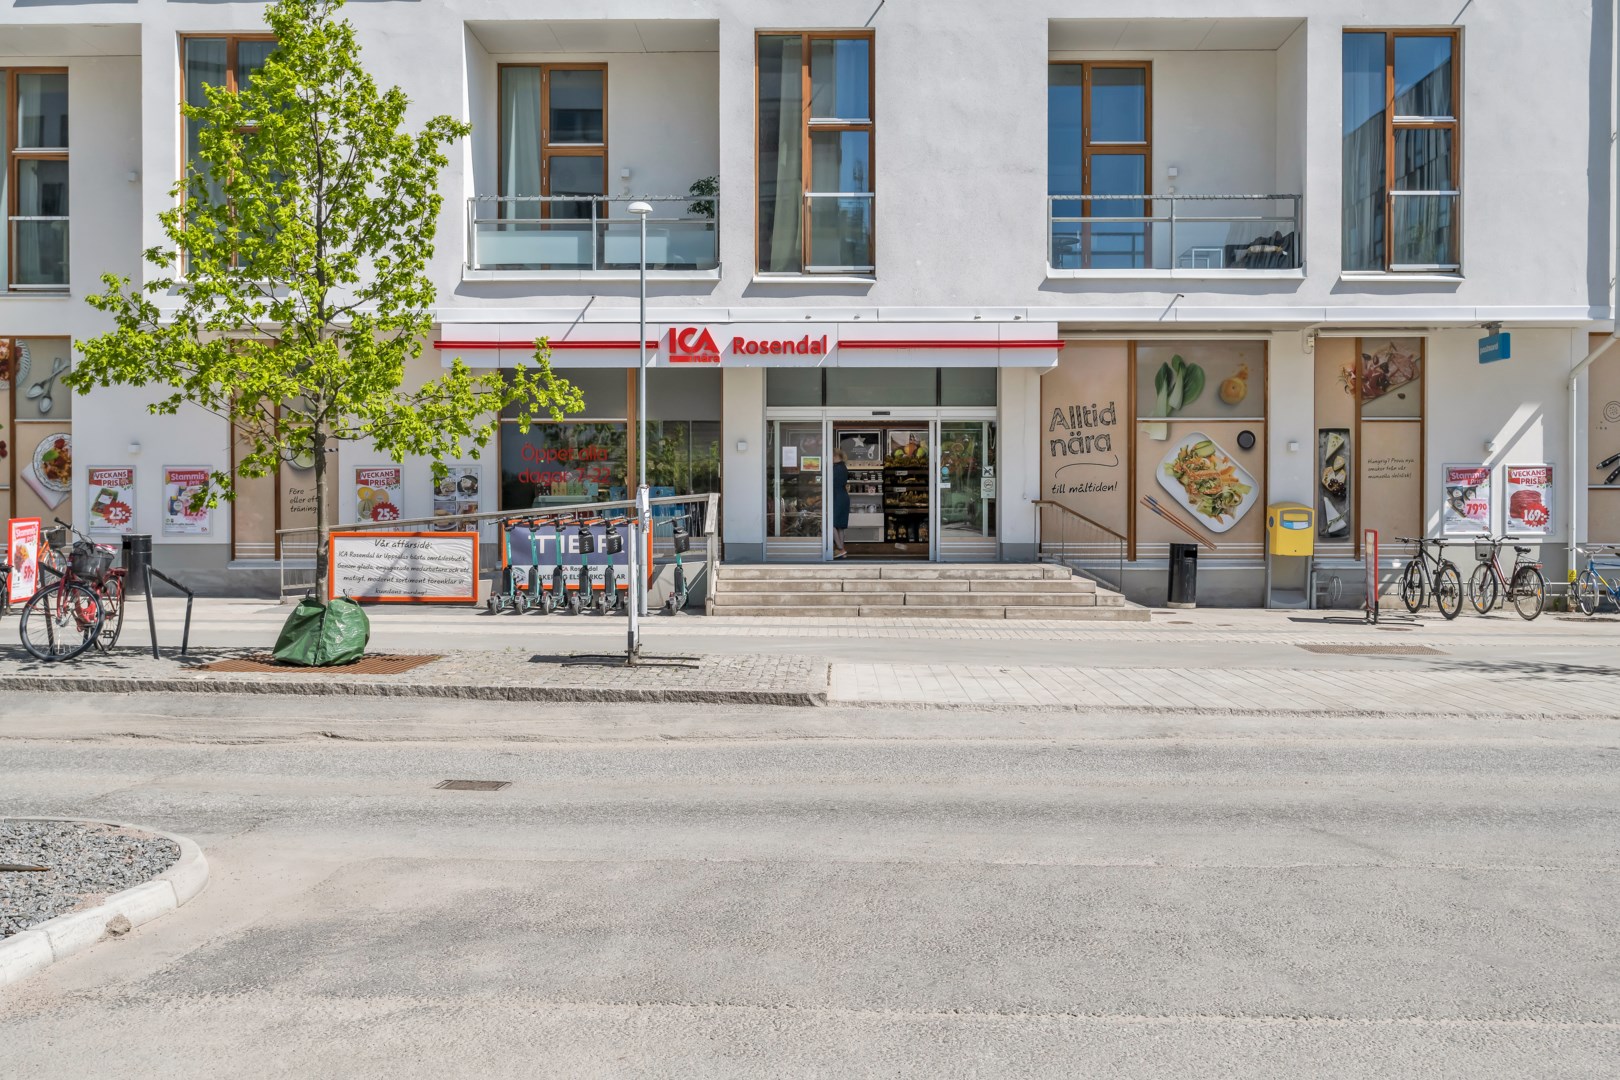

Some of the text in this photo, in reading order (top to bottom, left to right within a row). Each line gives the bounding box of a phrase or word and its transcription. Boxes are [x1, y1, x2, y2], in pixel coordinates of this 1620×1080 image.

[669, 327, 827, 354] ICA Rosendal
[1049, 401, 1117, 432] Alltid
[1050, 431, 1112, 457] nära
[521, 442, 608, 464] Öppet alla
[94, 470, 127, 479] VECKANS
[170, 472, 205, 481] Stammis
[363, 470, 394, 479] VECKANS
[518, 467, 567, 486] dagar
[1451, 470, 1486, 480] Stammis
[1513, 469, 1546, 477] VECKANS
[289, 487, 305, 495] Före
[1051, 481, 1118, 494] till måltiden!
[290, 496, 306, 504] eller
[109, 507, 130, 518] 25:-
[290, 505, 317, 514] träning
[377, 508, 397, 520] 25:-
[1523, 509, 1547, 521] 169:-
[374, 539, 433, 549] Vår affärsidé:
